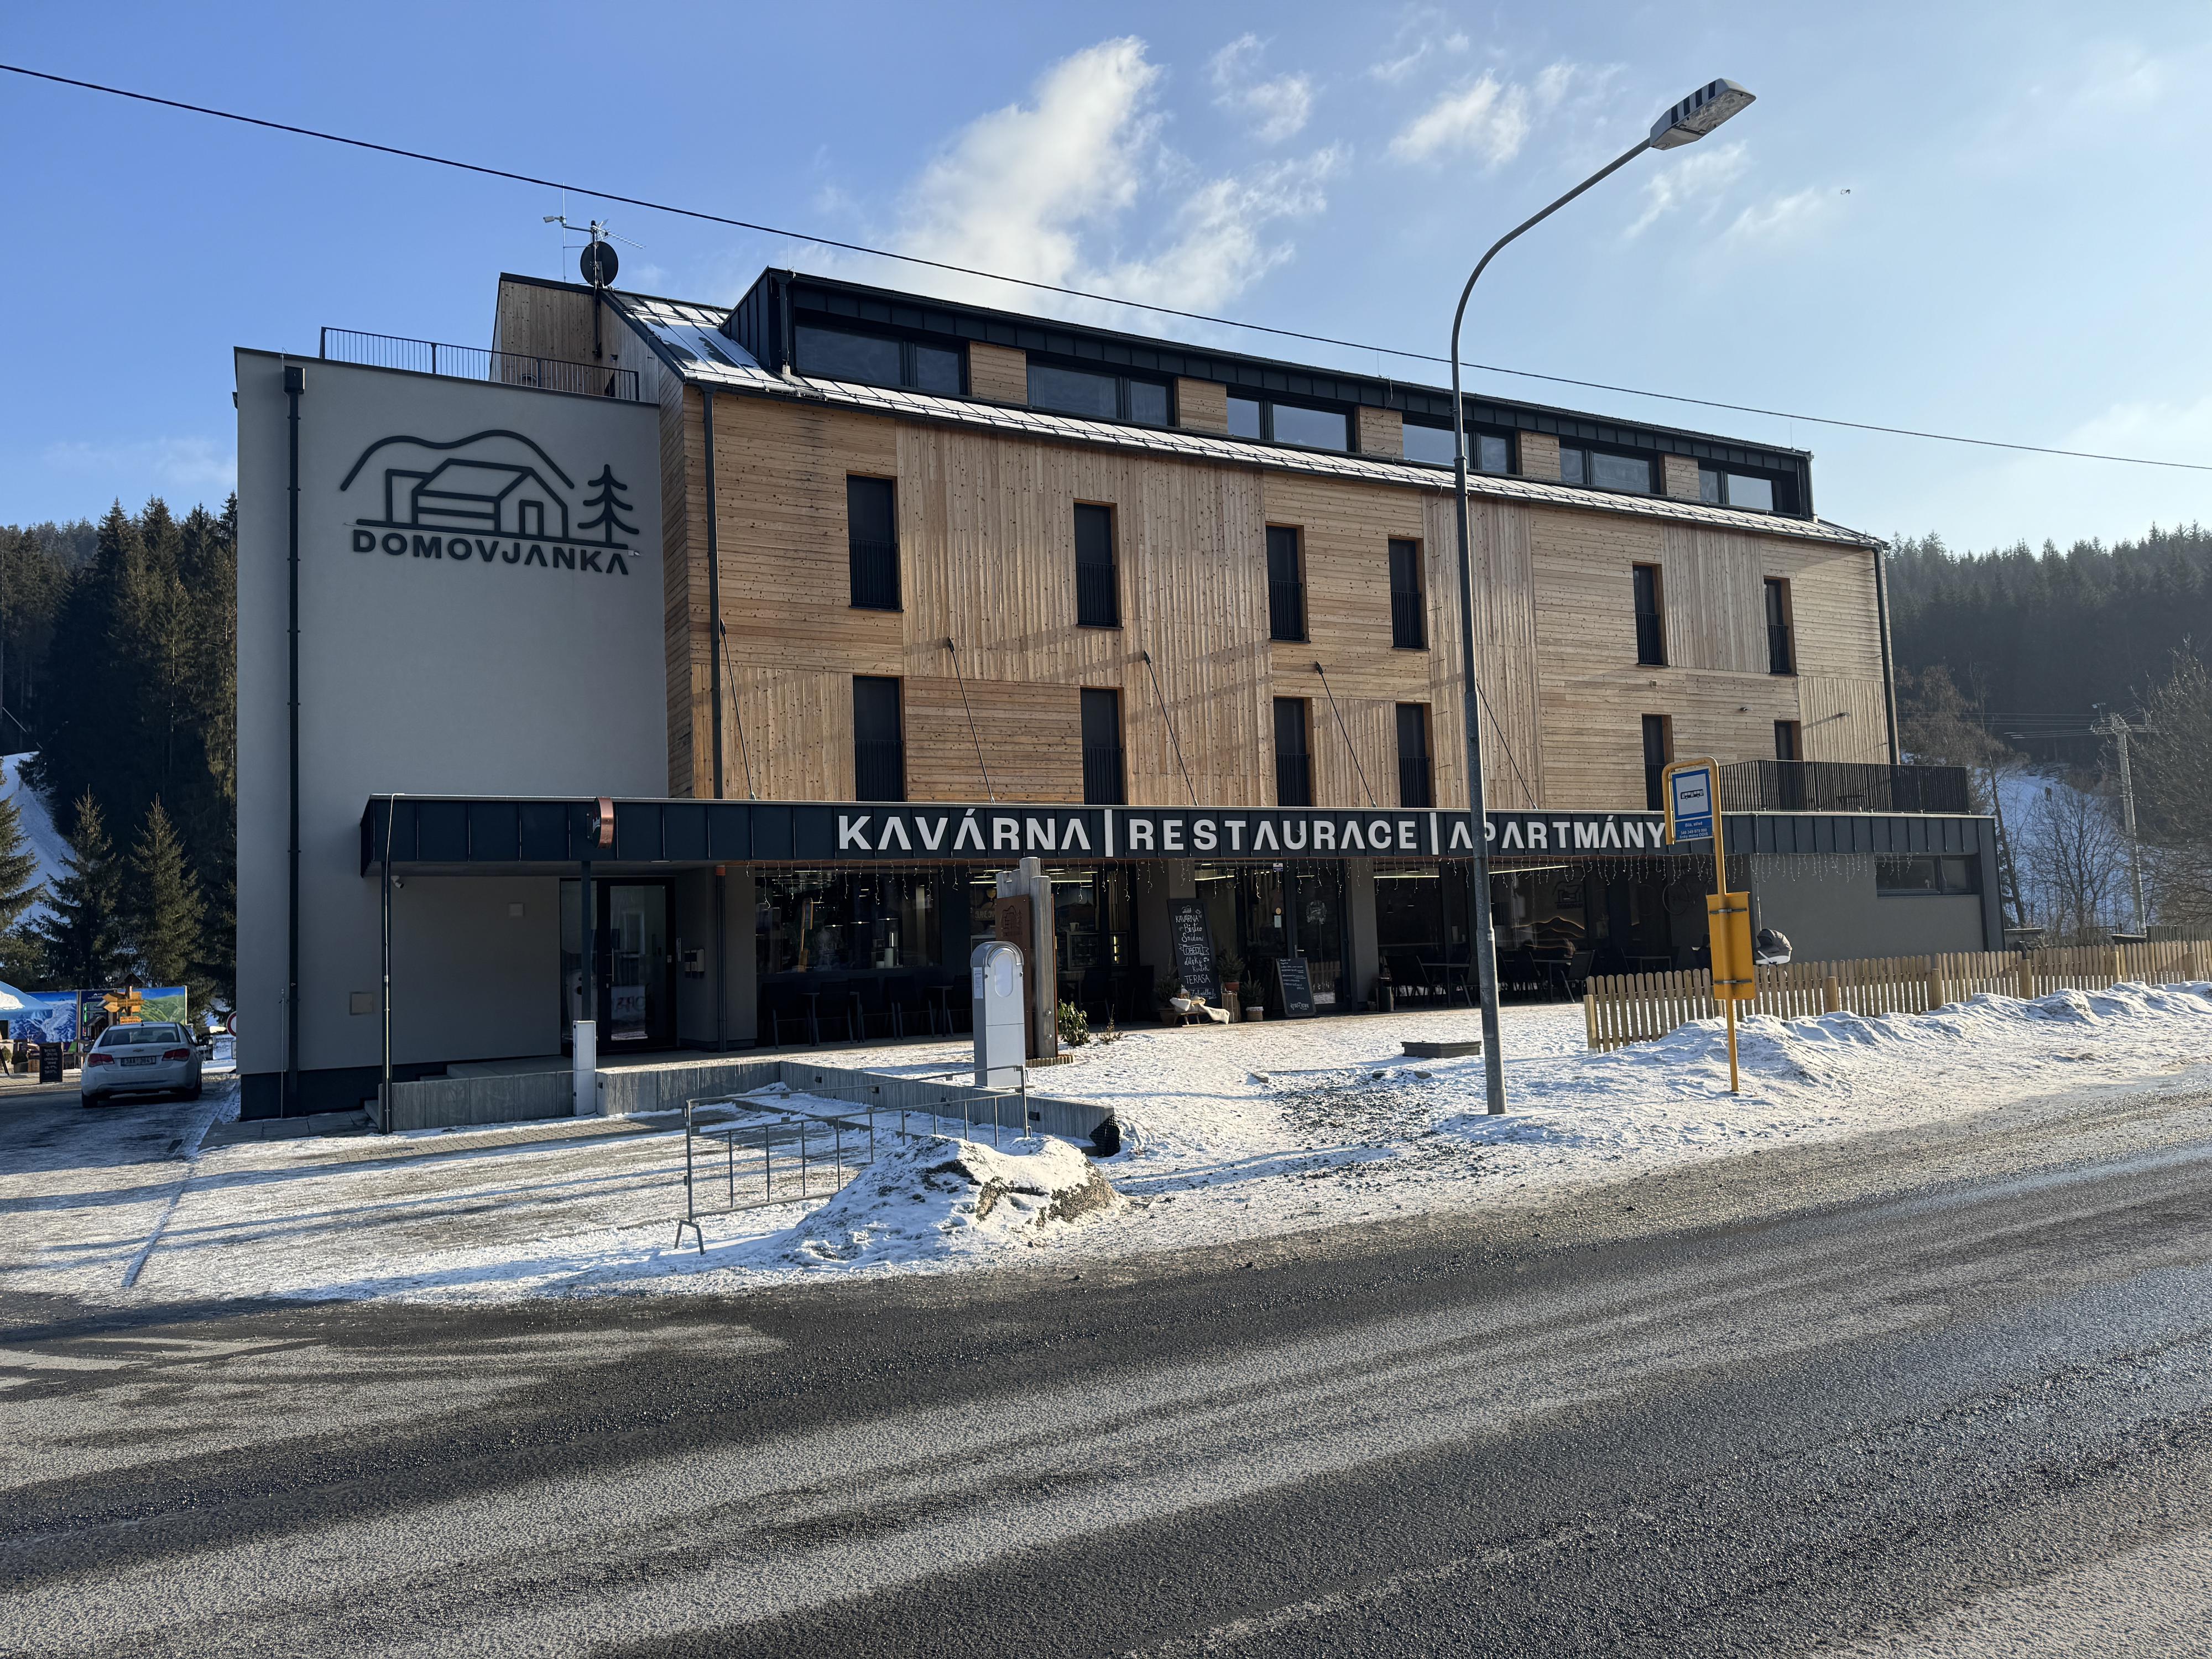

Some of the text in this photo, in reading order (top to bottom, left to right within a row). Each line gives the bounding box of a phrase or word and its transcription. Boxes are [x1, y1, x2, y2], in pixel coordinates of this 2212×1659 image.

[353, 529, 629, 575] DOMOVJANKA
[838, 807, 1091, 851] KAVÁRNA
[1129, 818, 1417, 851] RESTAURACE
[1183, 922, 1202, 933] Bistro
[1184, 974, 1211, 984] TERASA
